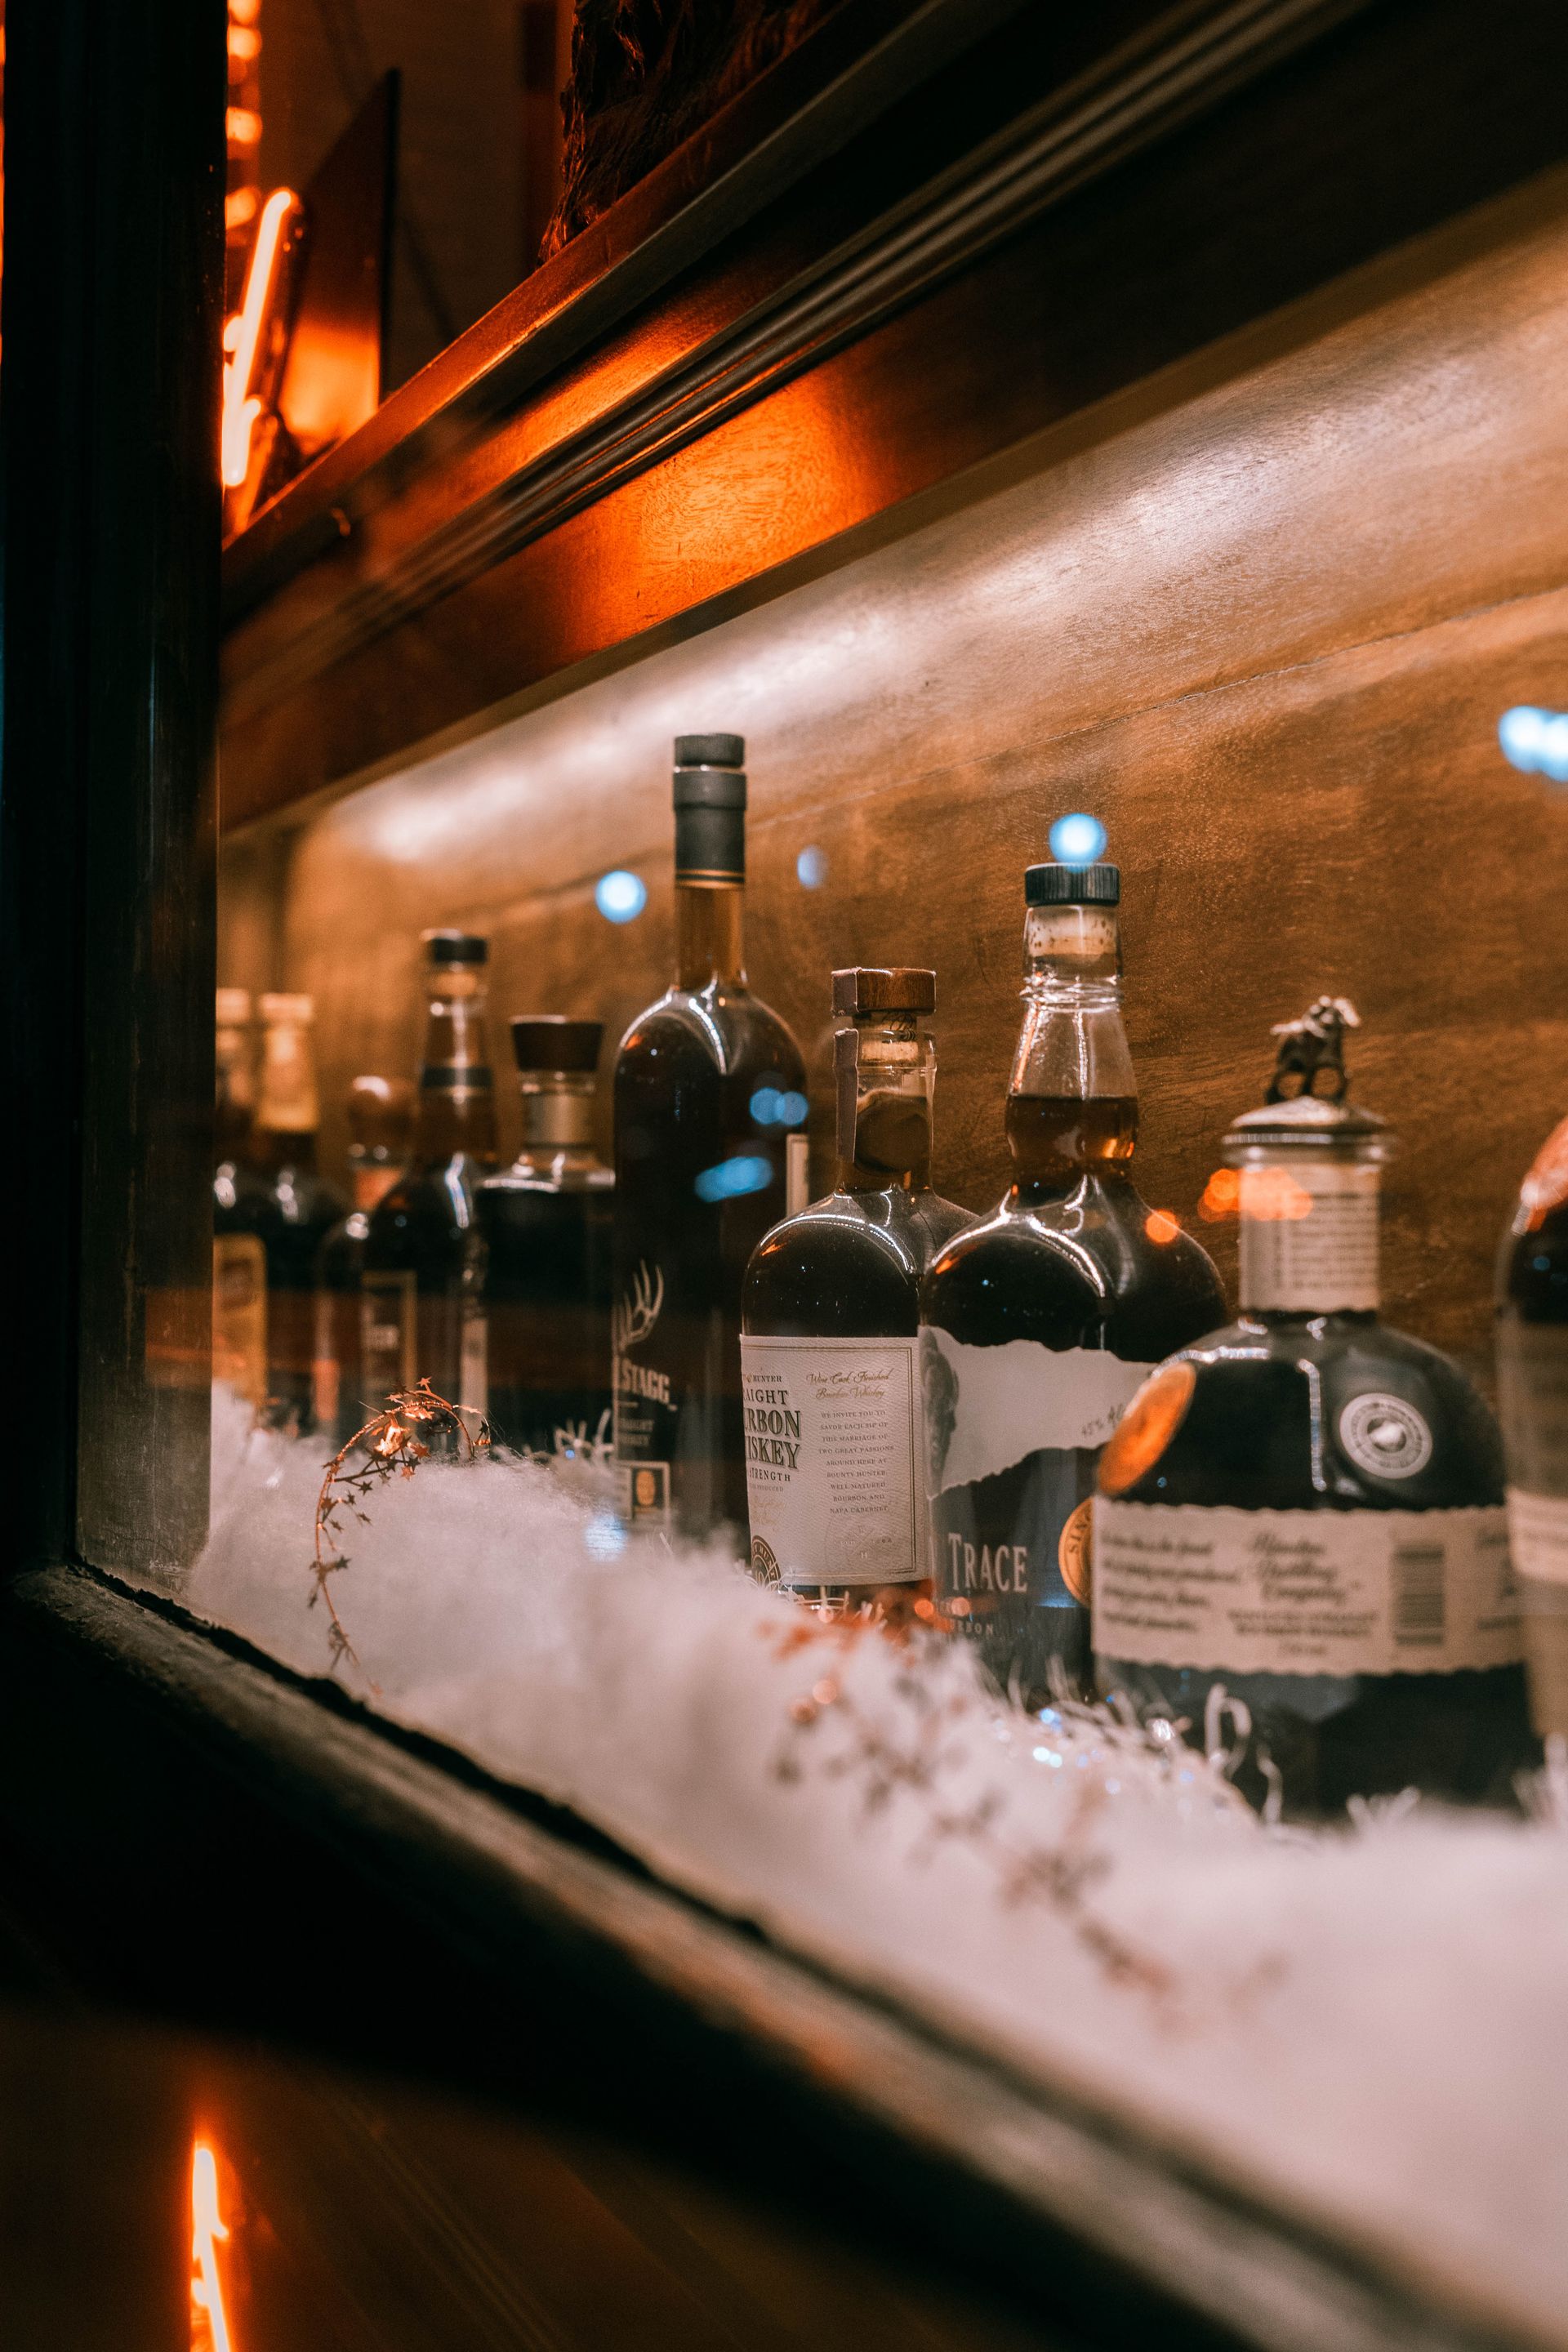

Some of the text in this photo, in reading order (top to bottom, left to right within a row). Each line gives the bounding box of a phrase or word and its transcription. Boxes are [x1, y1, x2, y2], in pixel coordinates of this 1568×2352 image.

[744, 1388, 788, 1405] AIGHT
[745, 1436, 800, 1469] ISKEY
[948, 1532, 1028, 1592] TRACE
